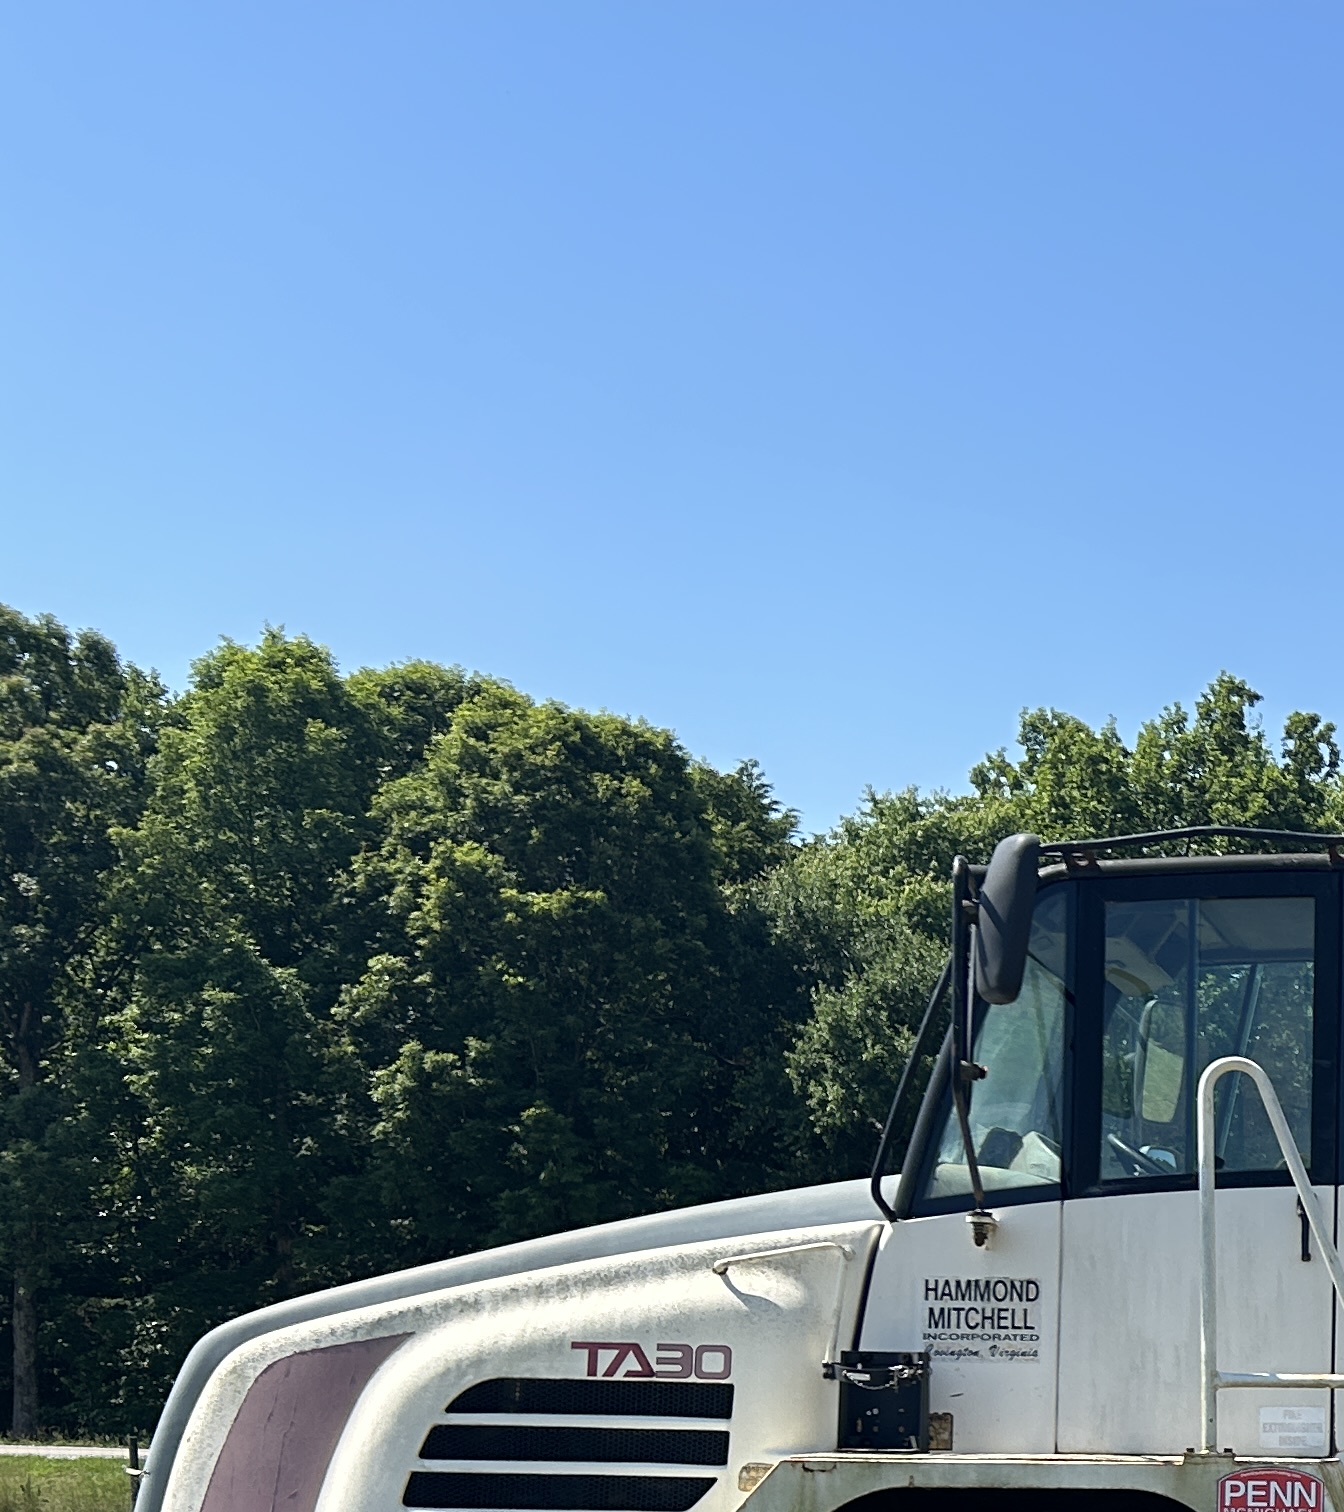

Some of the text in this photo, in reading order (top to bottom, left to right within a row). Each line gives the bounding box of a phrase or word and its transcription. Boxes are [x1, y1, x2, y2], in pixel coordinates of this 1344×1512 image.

[925, 1279, 1040, 1302] HAMMOND
[928, 1307, 1035, 1330] MITCHELL
[923, 1333, 1040, 1341] INCORPORATED
[571, 1342, 732, 1380] TA30
[988, 1344, 1039, 1360] Virginia
[1225, 1480, 1316, 1507] PENN
